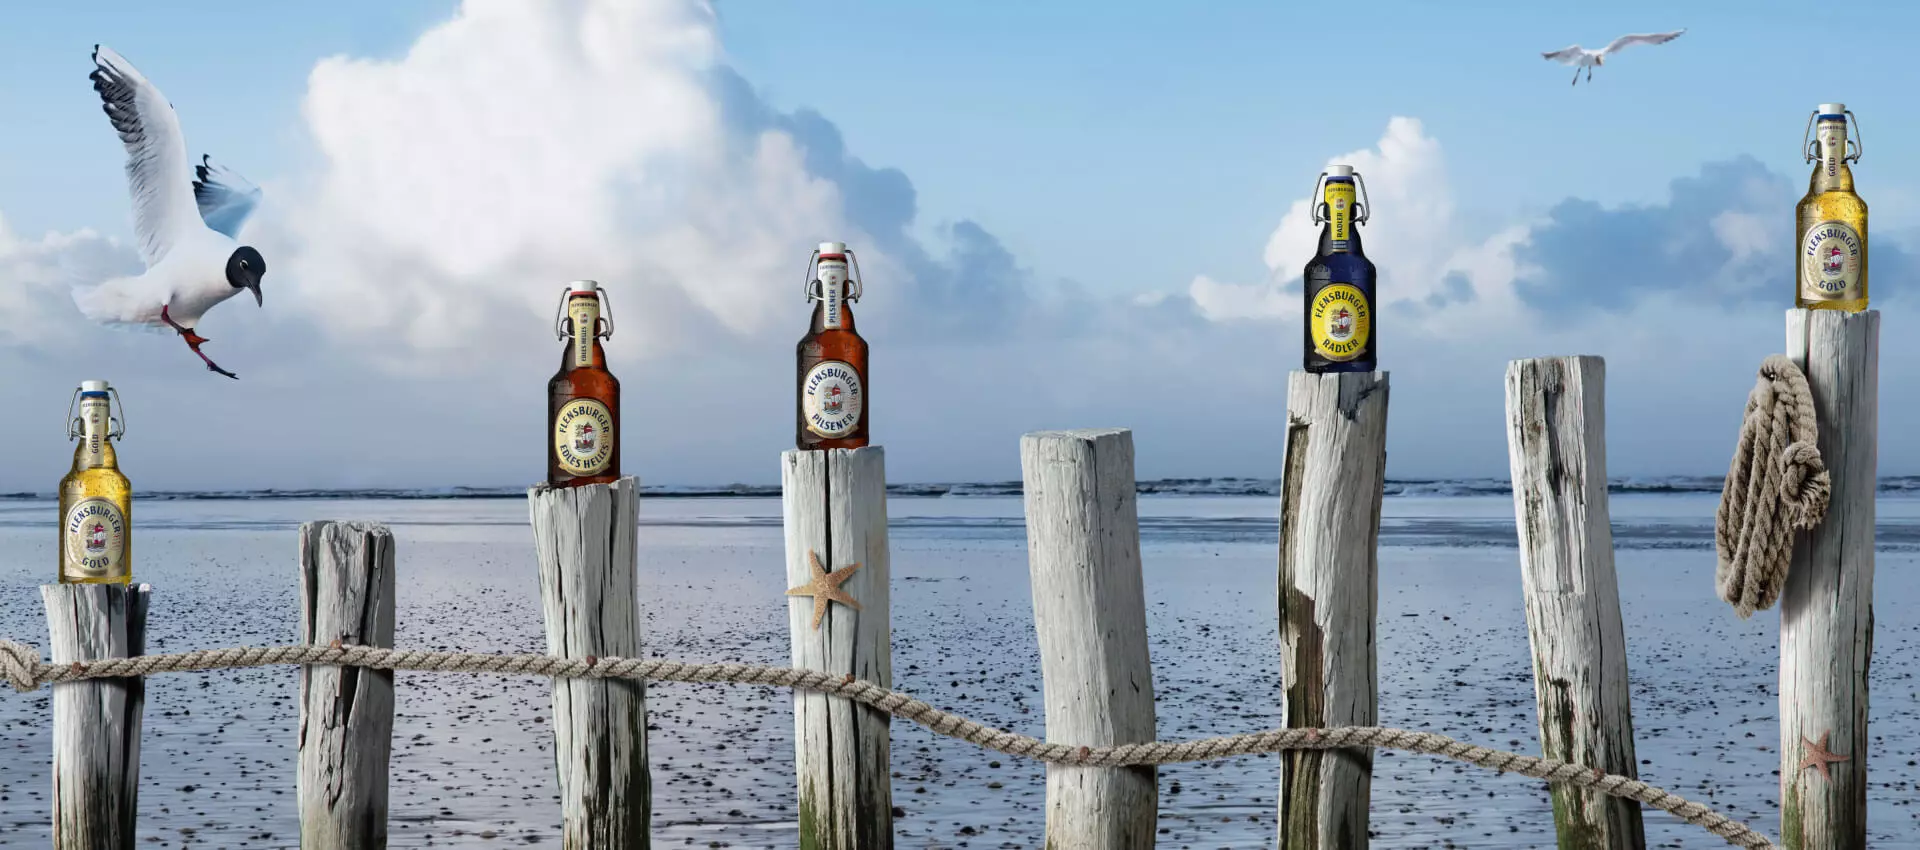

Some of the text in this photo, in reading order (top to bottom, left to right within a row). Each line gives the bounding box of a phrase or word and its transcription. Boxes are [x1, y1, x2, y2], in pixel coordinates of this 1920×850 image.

[1808, 228, 1858, 256] FLENSBURGER
[1819, 280, 1846, 291] GOLD
[1315, 291, 1366, 318] FLENSBURGER
[1322, 338, 1360, 352] RADLER
[808, 368, 858, 396] FLENSBURGER
[560, 406, 610, 433] FLENSBURGER
[812, 413, 854, 430] PILSENER
[560, 444, 608, 468] EDLES HELLES
[70, 505, 120, 534] FLENSBURGER
[82, 556, 110, 568] GOLD
